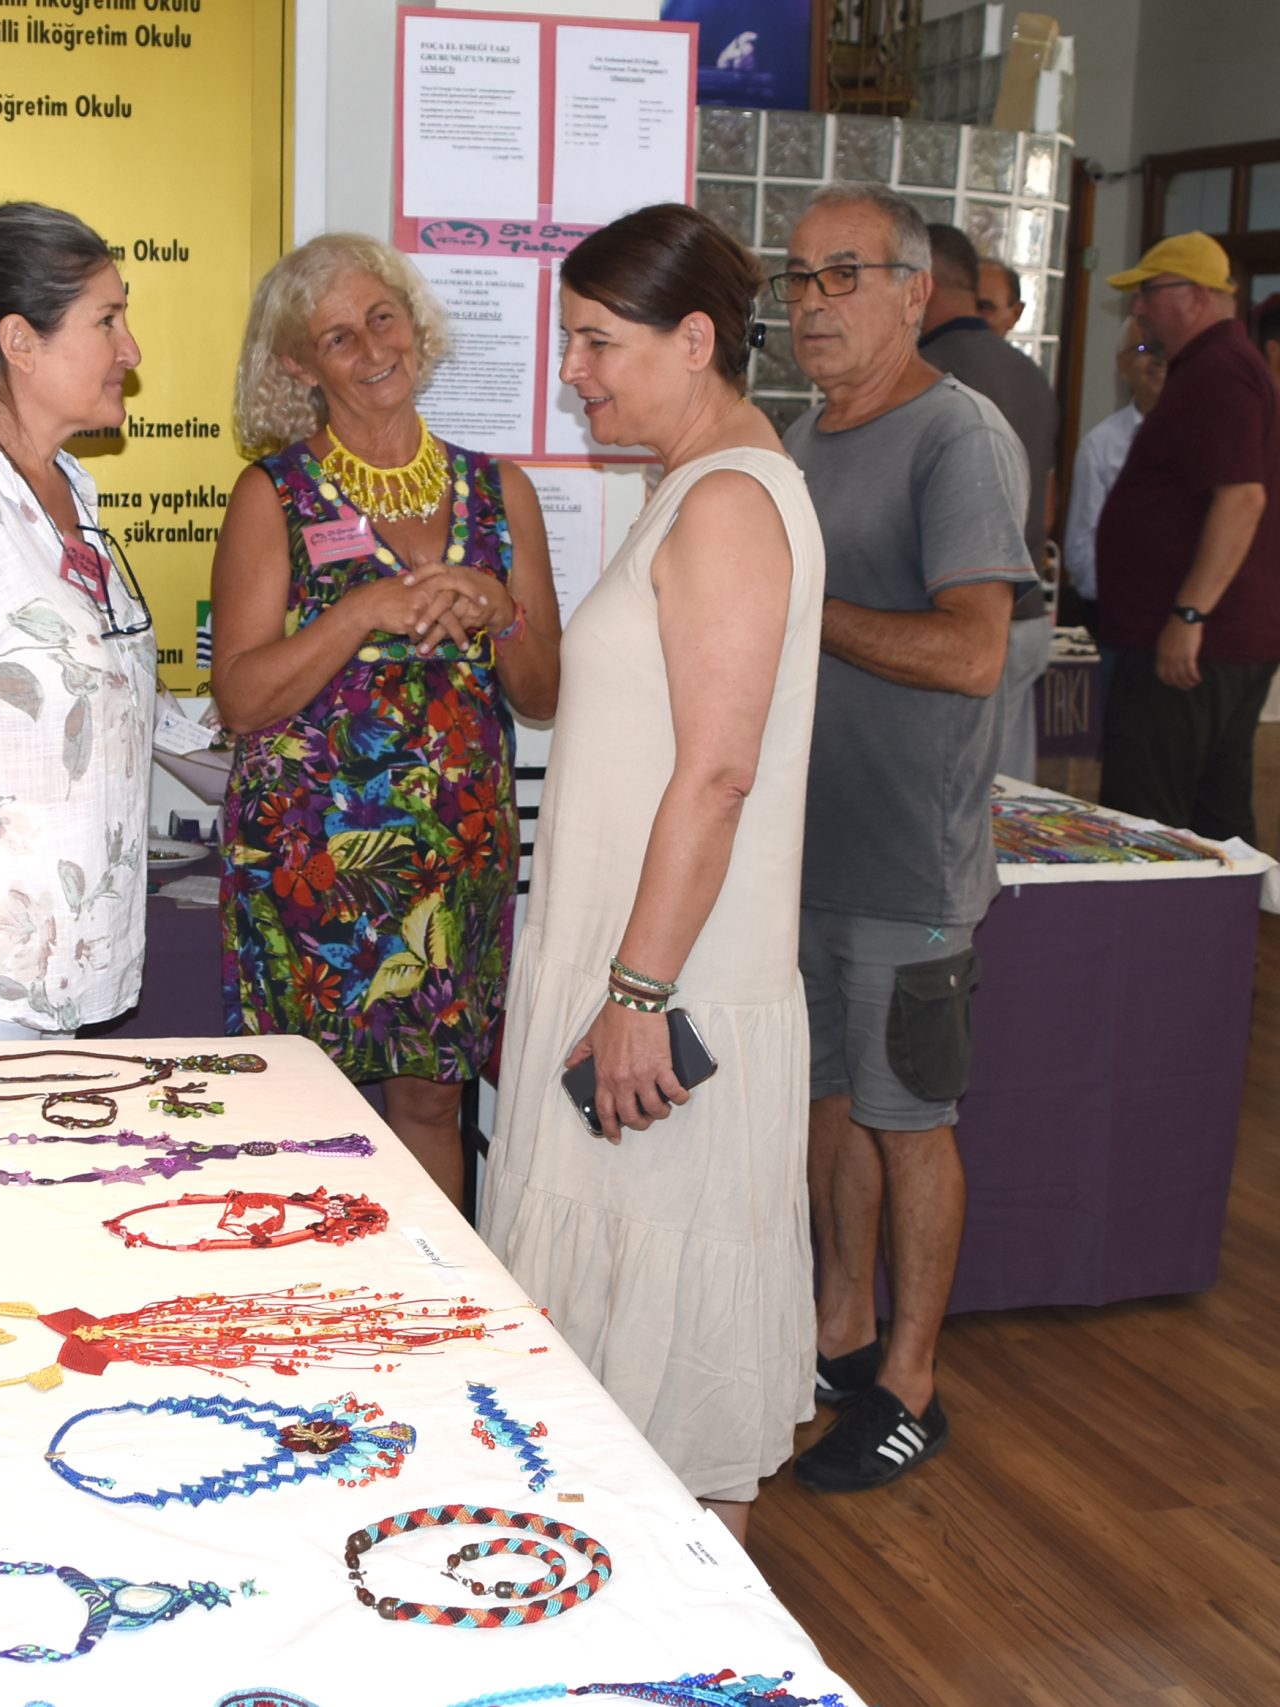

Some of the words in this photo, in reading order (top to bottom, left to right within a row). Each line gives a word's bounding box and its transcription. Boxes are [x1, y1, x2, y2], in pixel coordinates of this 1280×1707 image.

[27, 15, 128, 51] İlköğretim
[135, 24, 192, 48] Okulu
[76, 95, 132, 118] Okulu
[133, 238, 189, 261] Okulu
[128, 415, 220, 437] hizmetine
[150, 486, 230, 514] yaptıkla
[124, 520, 219, 548] şükranları
[1044, 667, 1090, 737] TAKI
